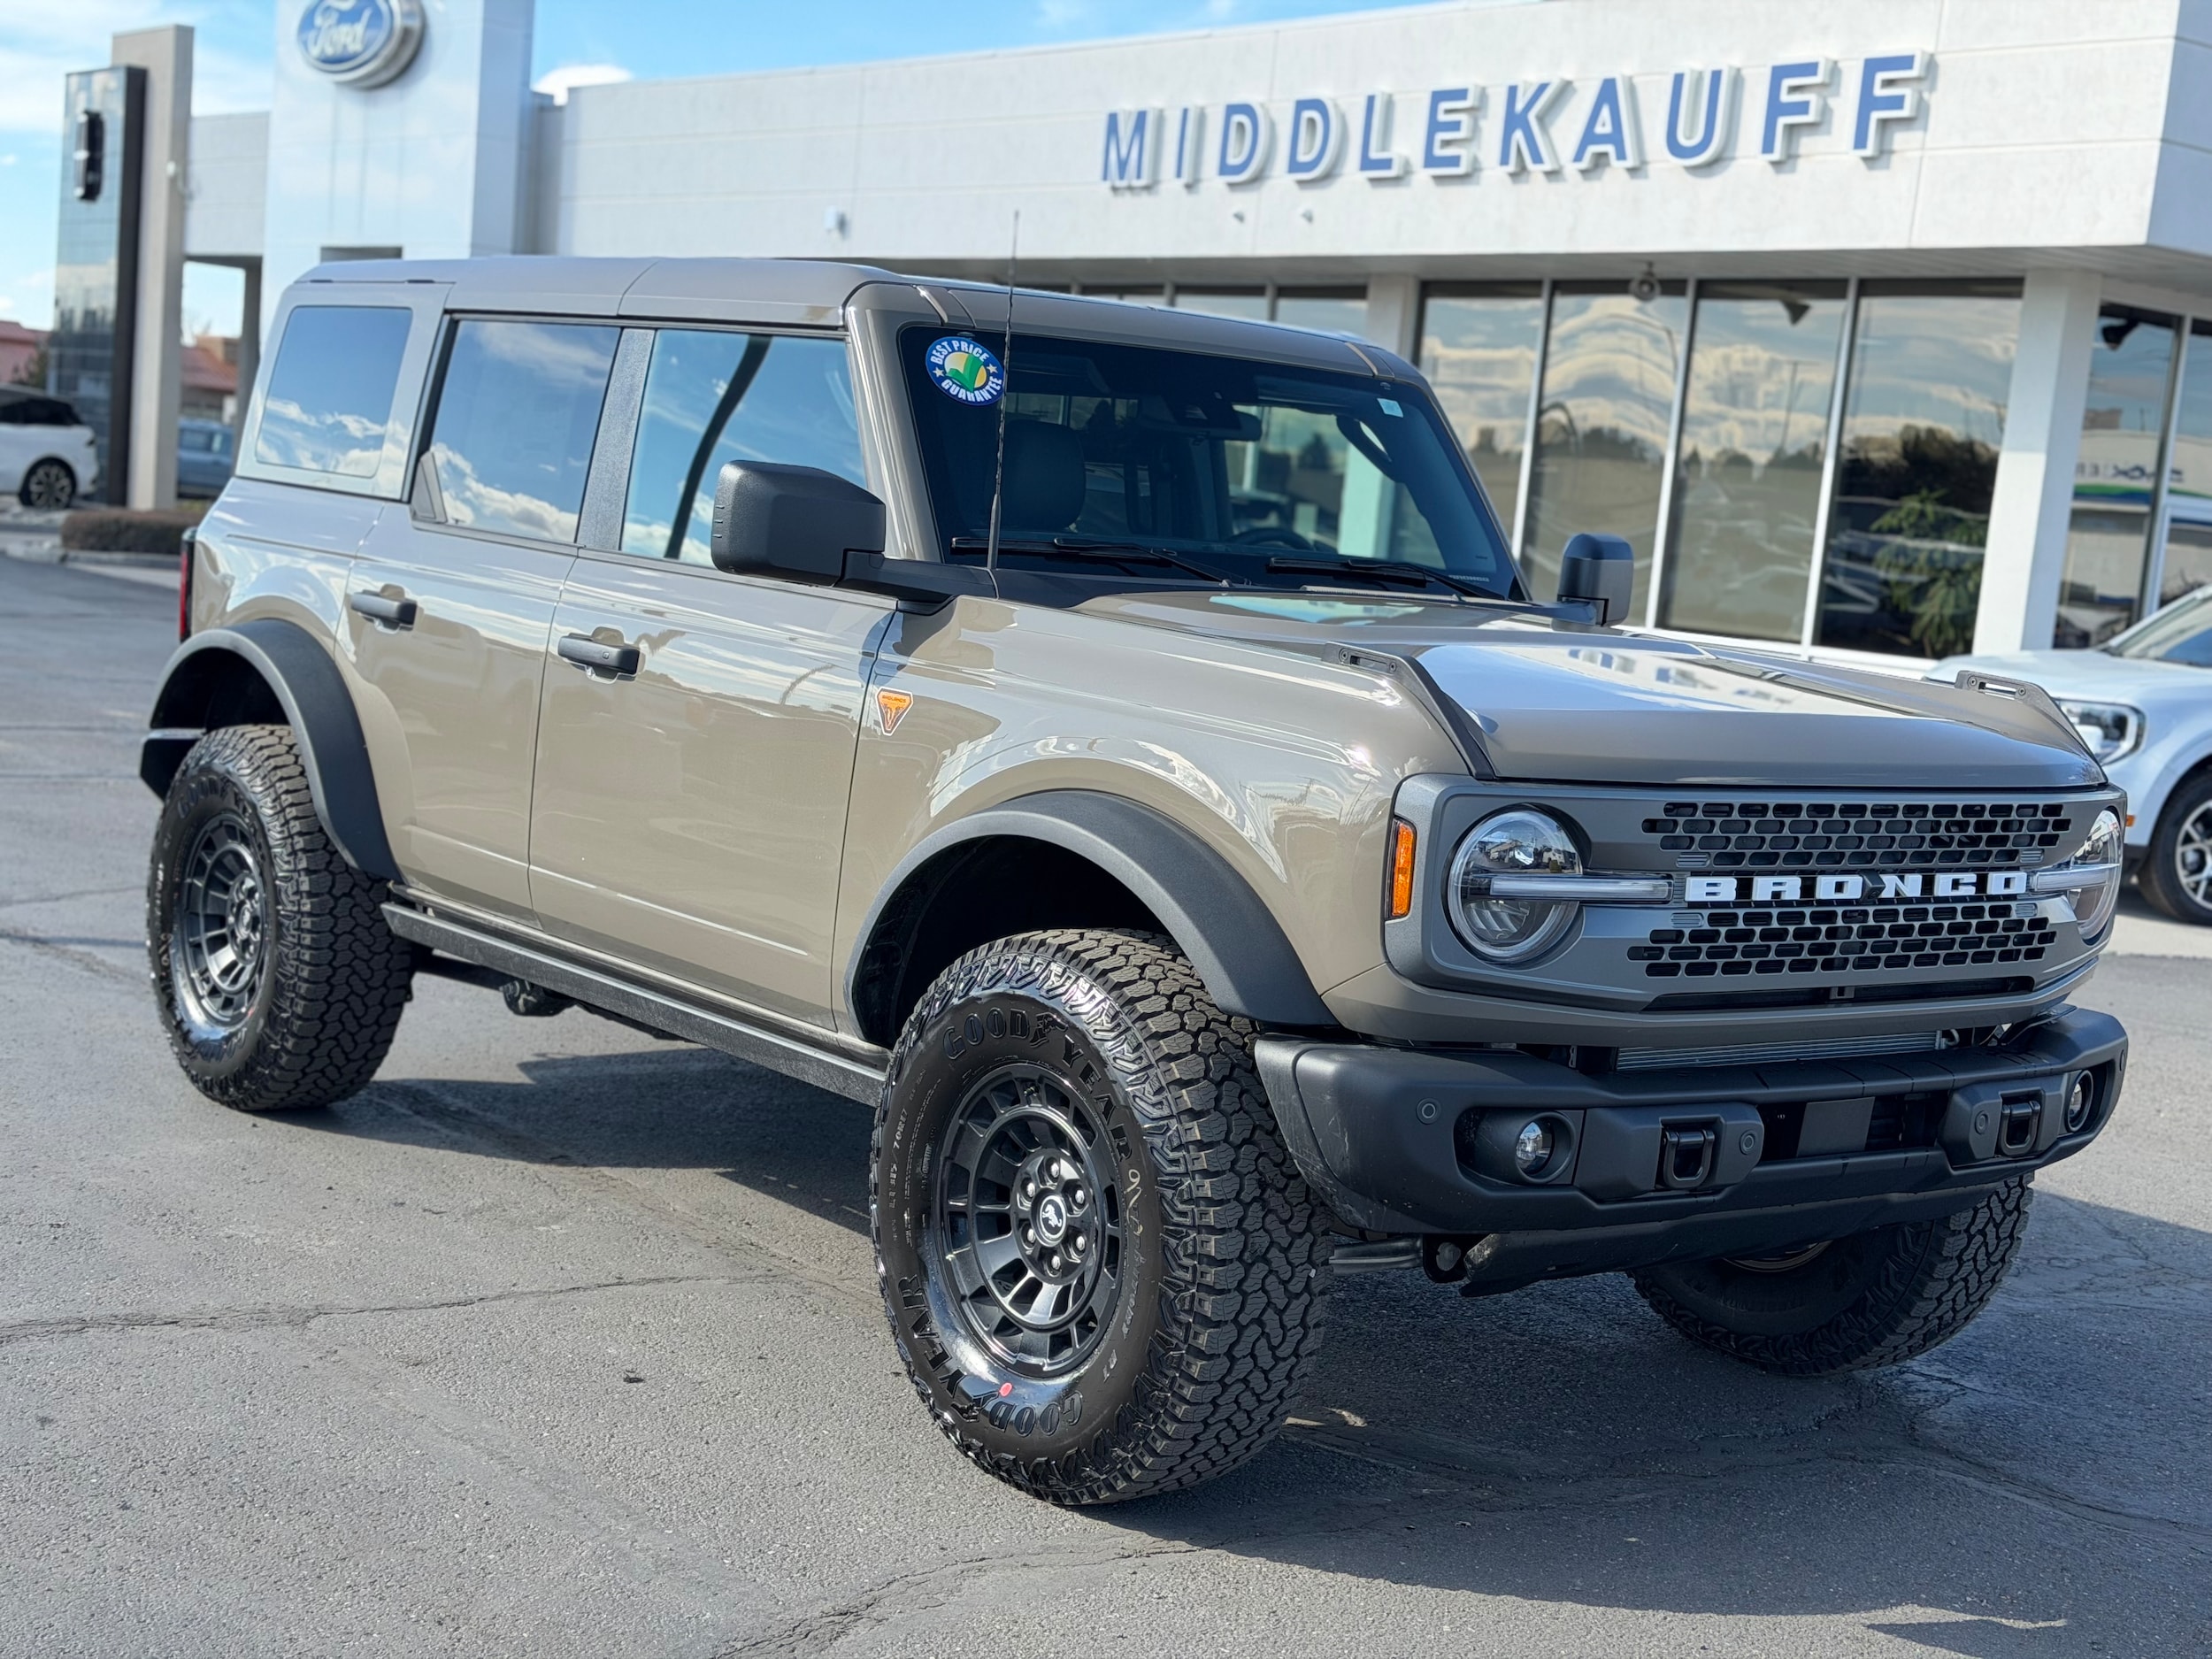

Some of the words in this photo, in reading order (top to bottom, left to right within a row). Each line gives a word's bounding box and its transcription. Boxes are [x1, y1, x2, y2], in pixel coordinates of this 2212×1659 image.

[307, 0, 373, 58] Ford
[1102, 50, 1929, 190] MIDDLEKAUFF
[930, 340, 953, 365] BEST
[951, 340, 990, 363] PRICE
[941, 375, 1002, 403] GUARANTEE
[1685, 871, 2029, 902] BRONCO
